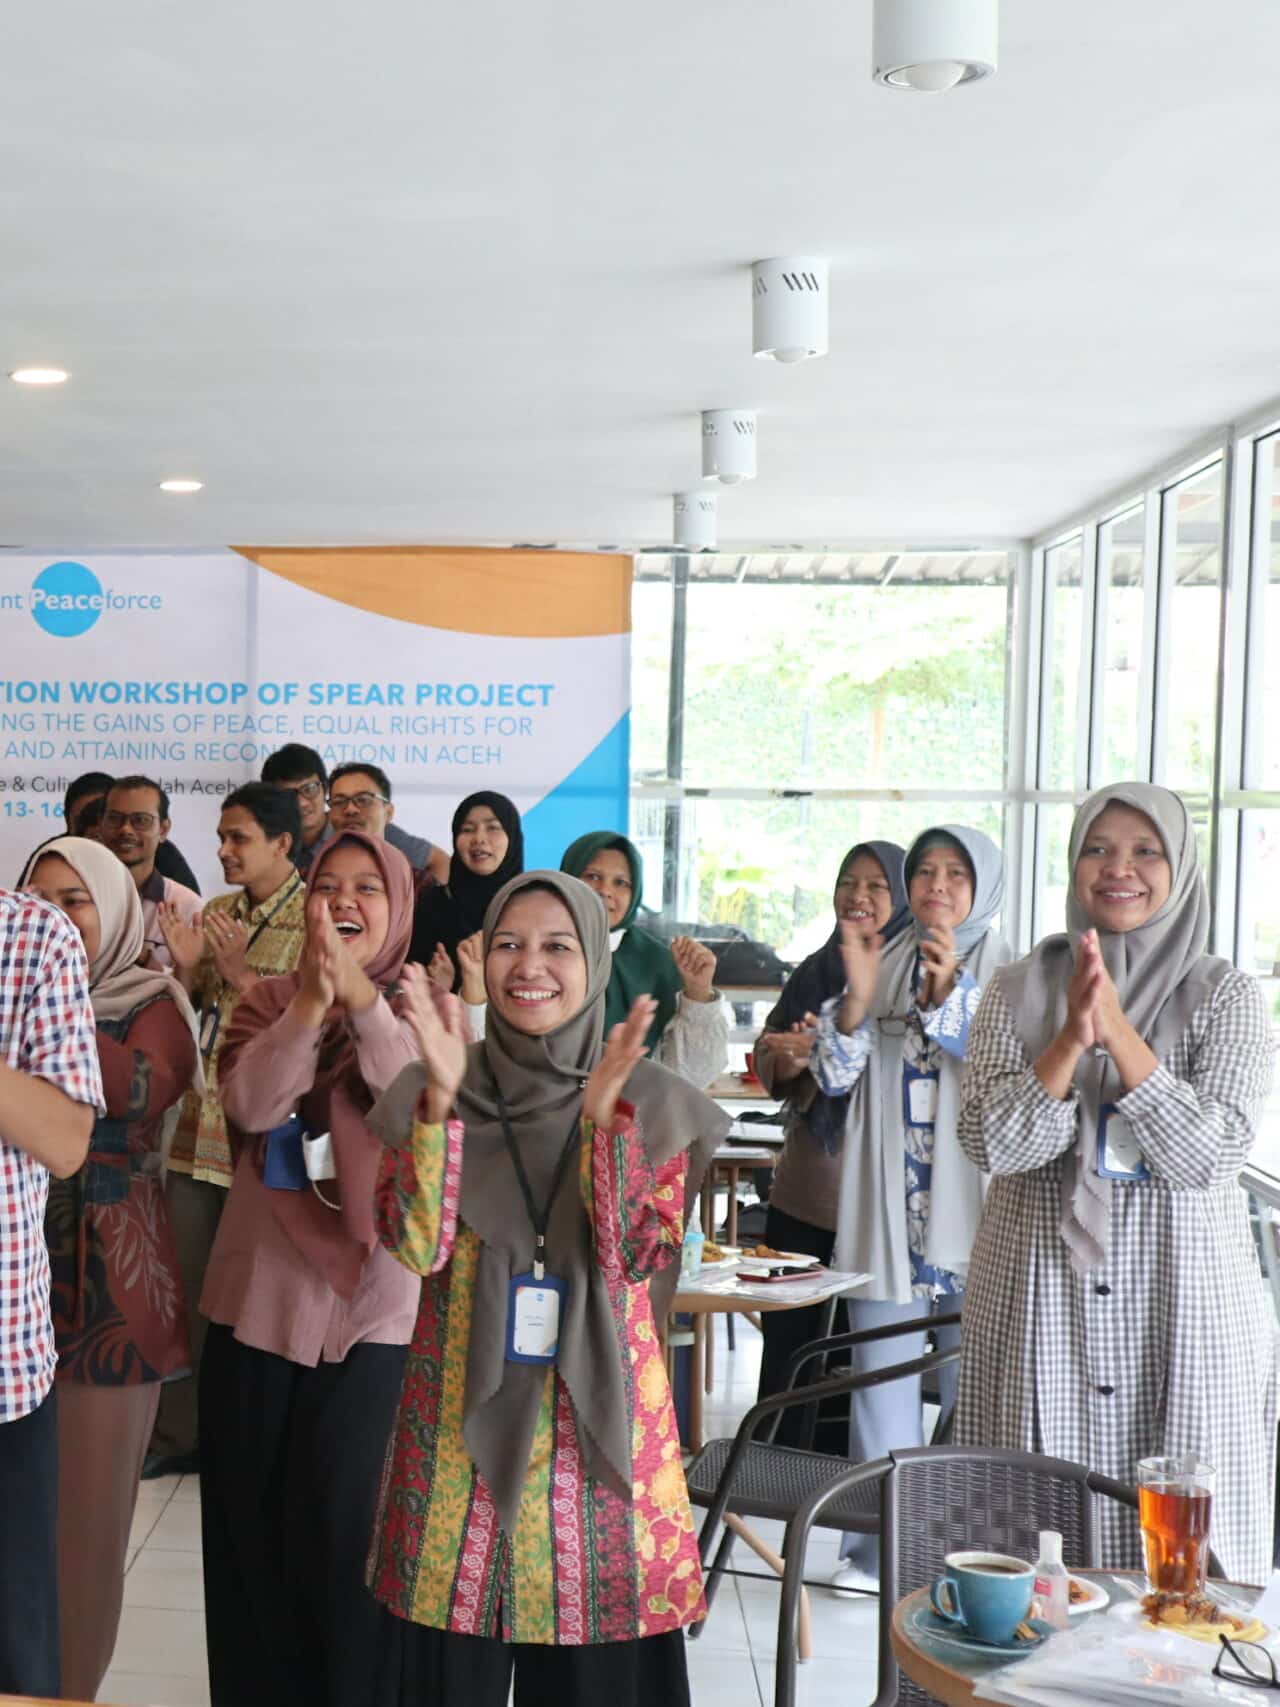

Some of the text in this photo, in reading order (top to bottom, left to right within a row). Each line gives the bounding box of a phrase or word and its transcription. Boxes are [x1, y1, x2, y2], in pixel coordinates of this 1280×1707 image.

[70, 681, 249, 705] WORKSHOP
[257, 682, 300, 705] OF
[308, 682, 405, 706] SPEAR
[415, 683, 556, 707] PROJECT
[40, 713, 85, 732] THE
[93, 713, 165, 733] GAINS
[173, 714, 207, 734] OF
[213, 714, 295, 737] PEACE,
[303, 715, 384, 735] EQUAL
[390, 716, 476, 736] RIGHTS
[484, 716, 533, 737] FOR
[4, 741, 502, 765] AND ATTAINING RECONATION IN ACEH
[12, 775, 26, 792] &
[41, 801, 65, 818] 16
